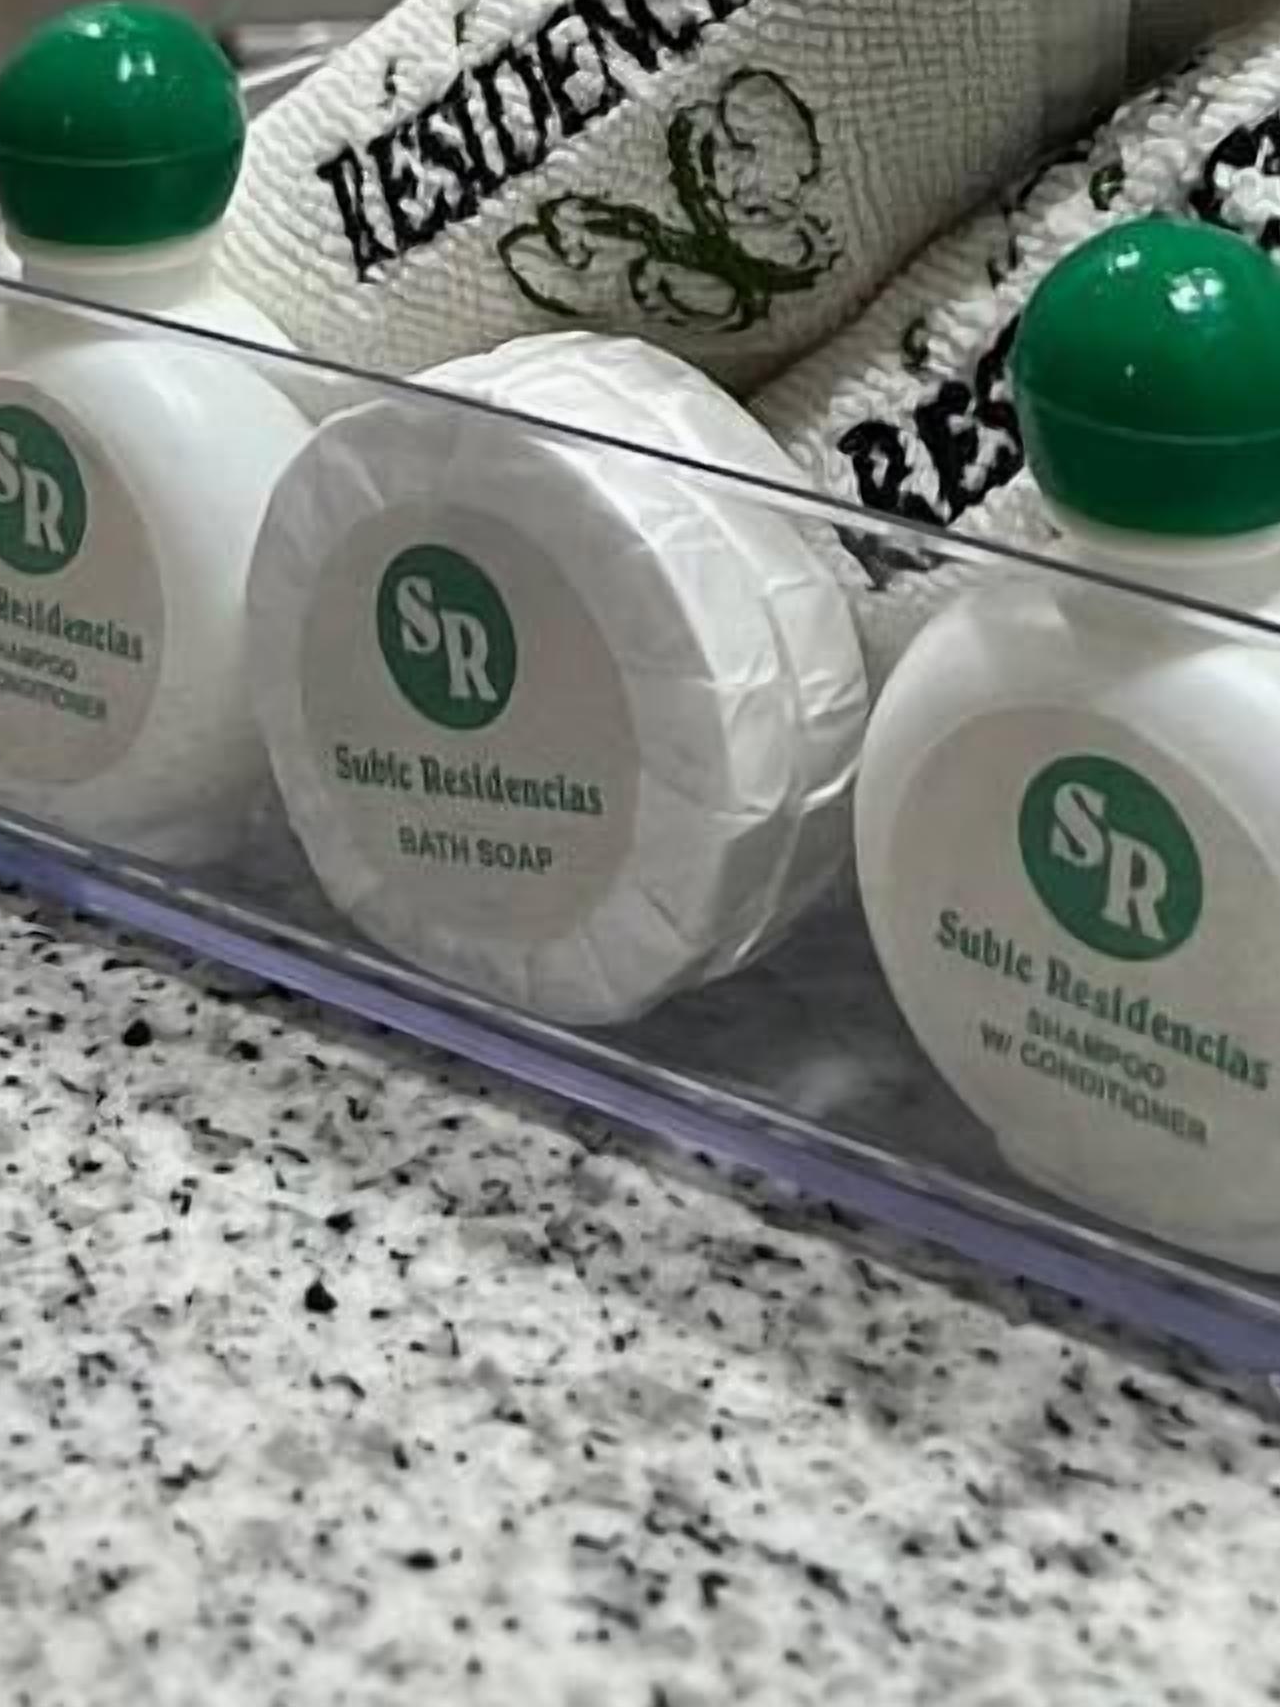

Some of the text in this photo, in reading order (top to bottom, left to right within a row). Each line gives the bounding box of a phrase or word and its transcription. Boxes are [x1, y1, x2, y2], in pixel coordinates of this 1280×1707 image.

[394, 574, 499, 703] SR
[334, 744, 605, 816] Subic Residencias
[398, 825, 553, 875] BATH SOAP
[1049, 781, 1168, 942] SR
[935, 909, 1272, 1092] Subic Residencias
[1026, 1005, 1167, 1090] SHAMPOO
[1019, 1040, 1209, 1146] CONDITIONER
